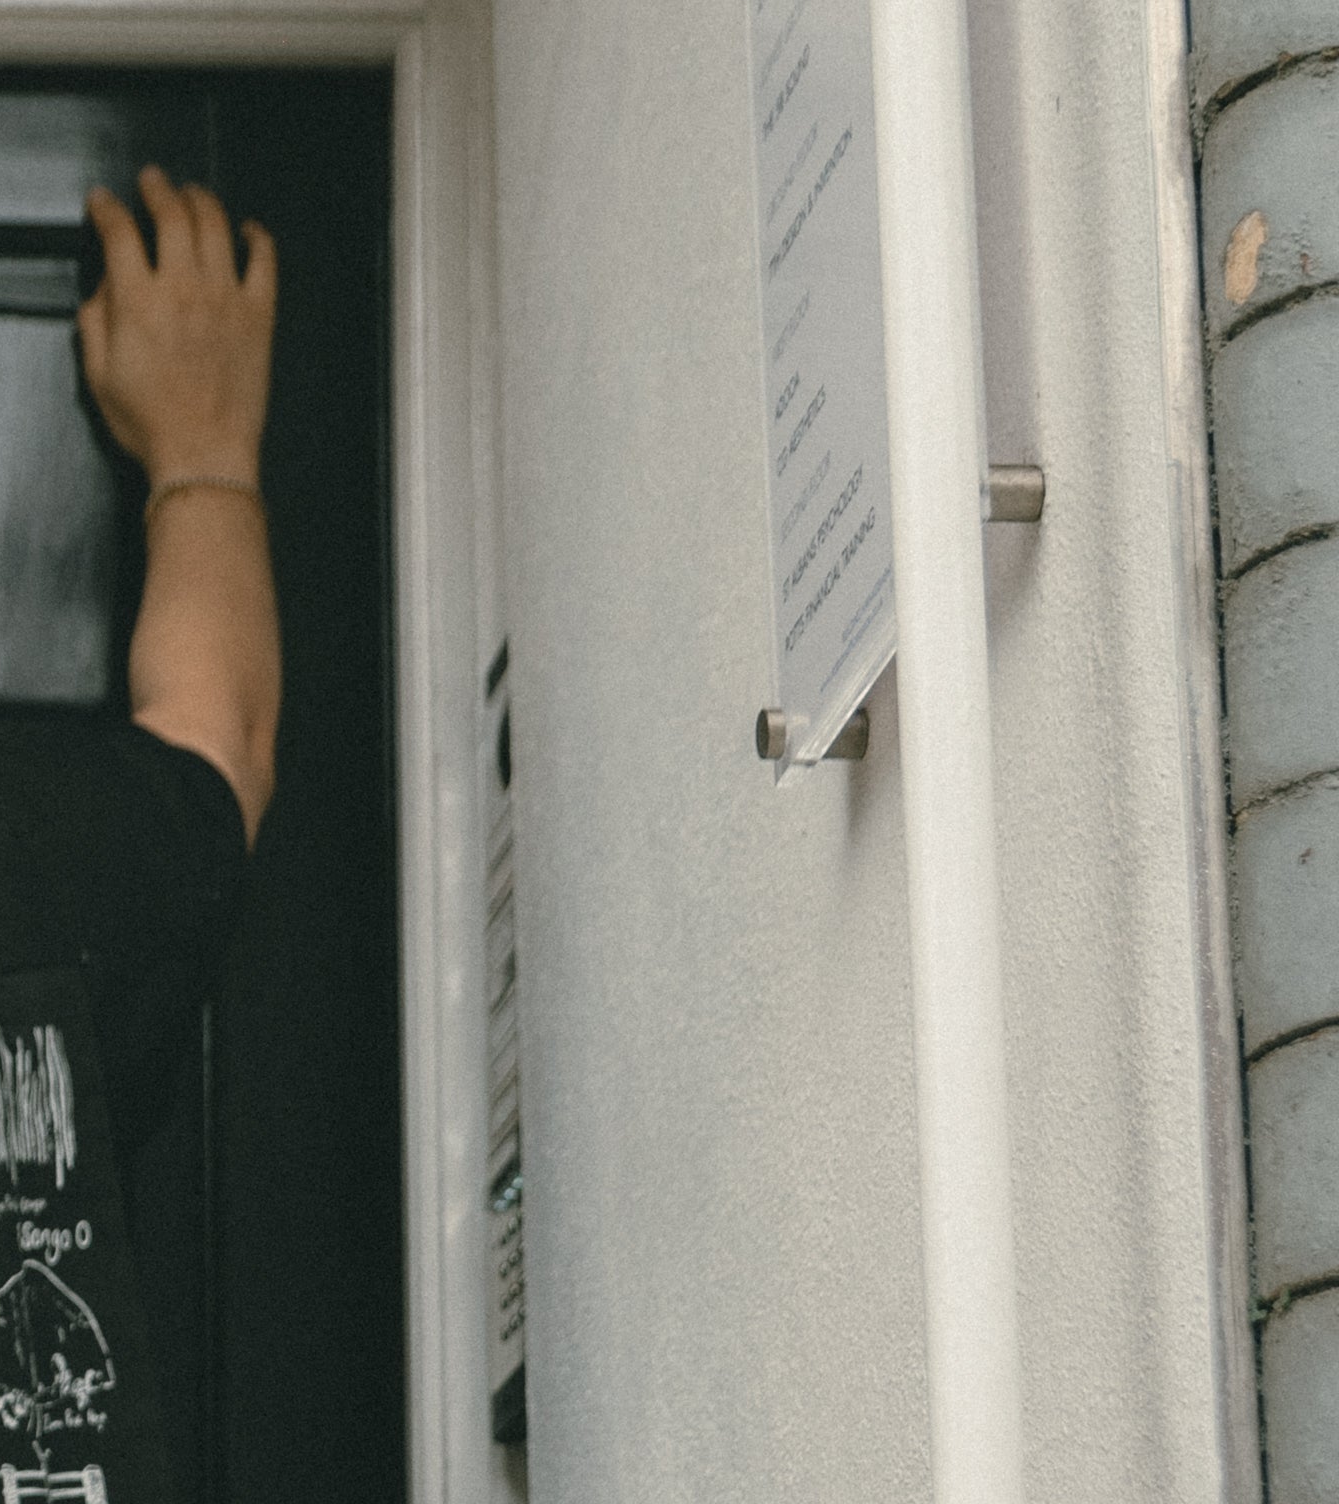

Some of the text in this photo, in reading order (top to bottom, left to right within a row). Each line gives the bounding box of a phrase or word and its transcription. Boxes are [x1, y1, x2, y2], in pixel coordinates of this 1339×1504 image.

[792, 536, 817, 585] ALBANS
[818, 462, 863, 544] PSYCHOLOGY
[806, 561, 841, 615] FINANCIAL
[841, 506, 875, 567] TRAINING
